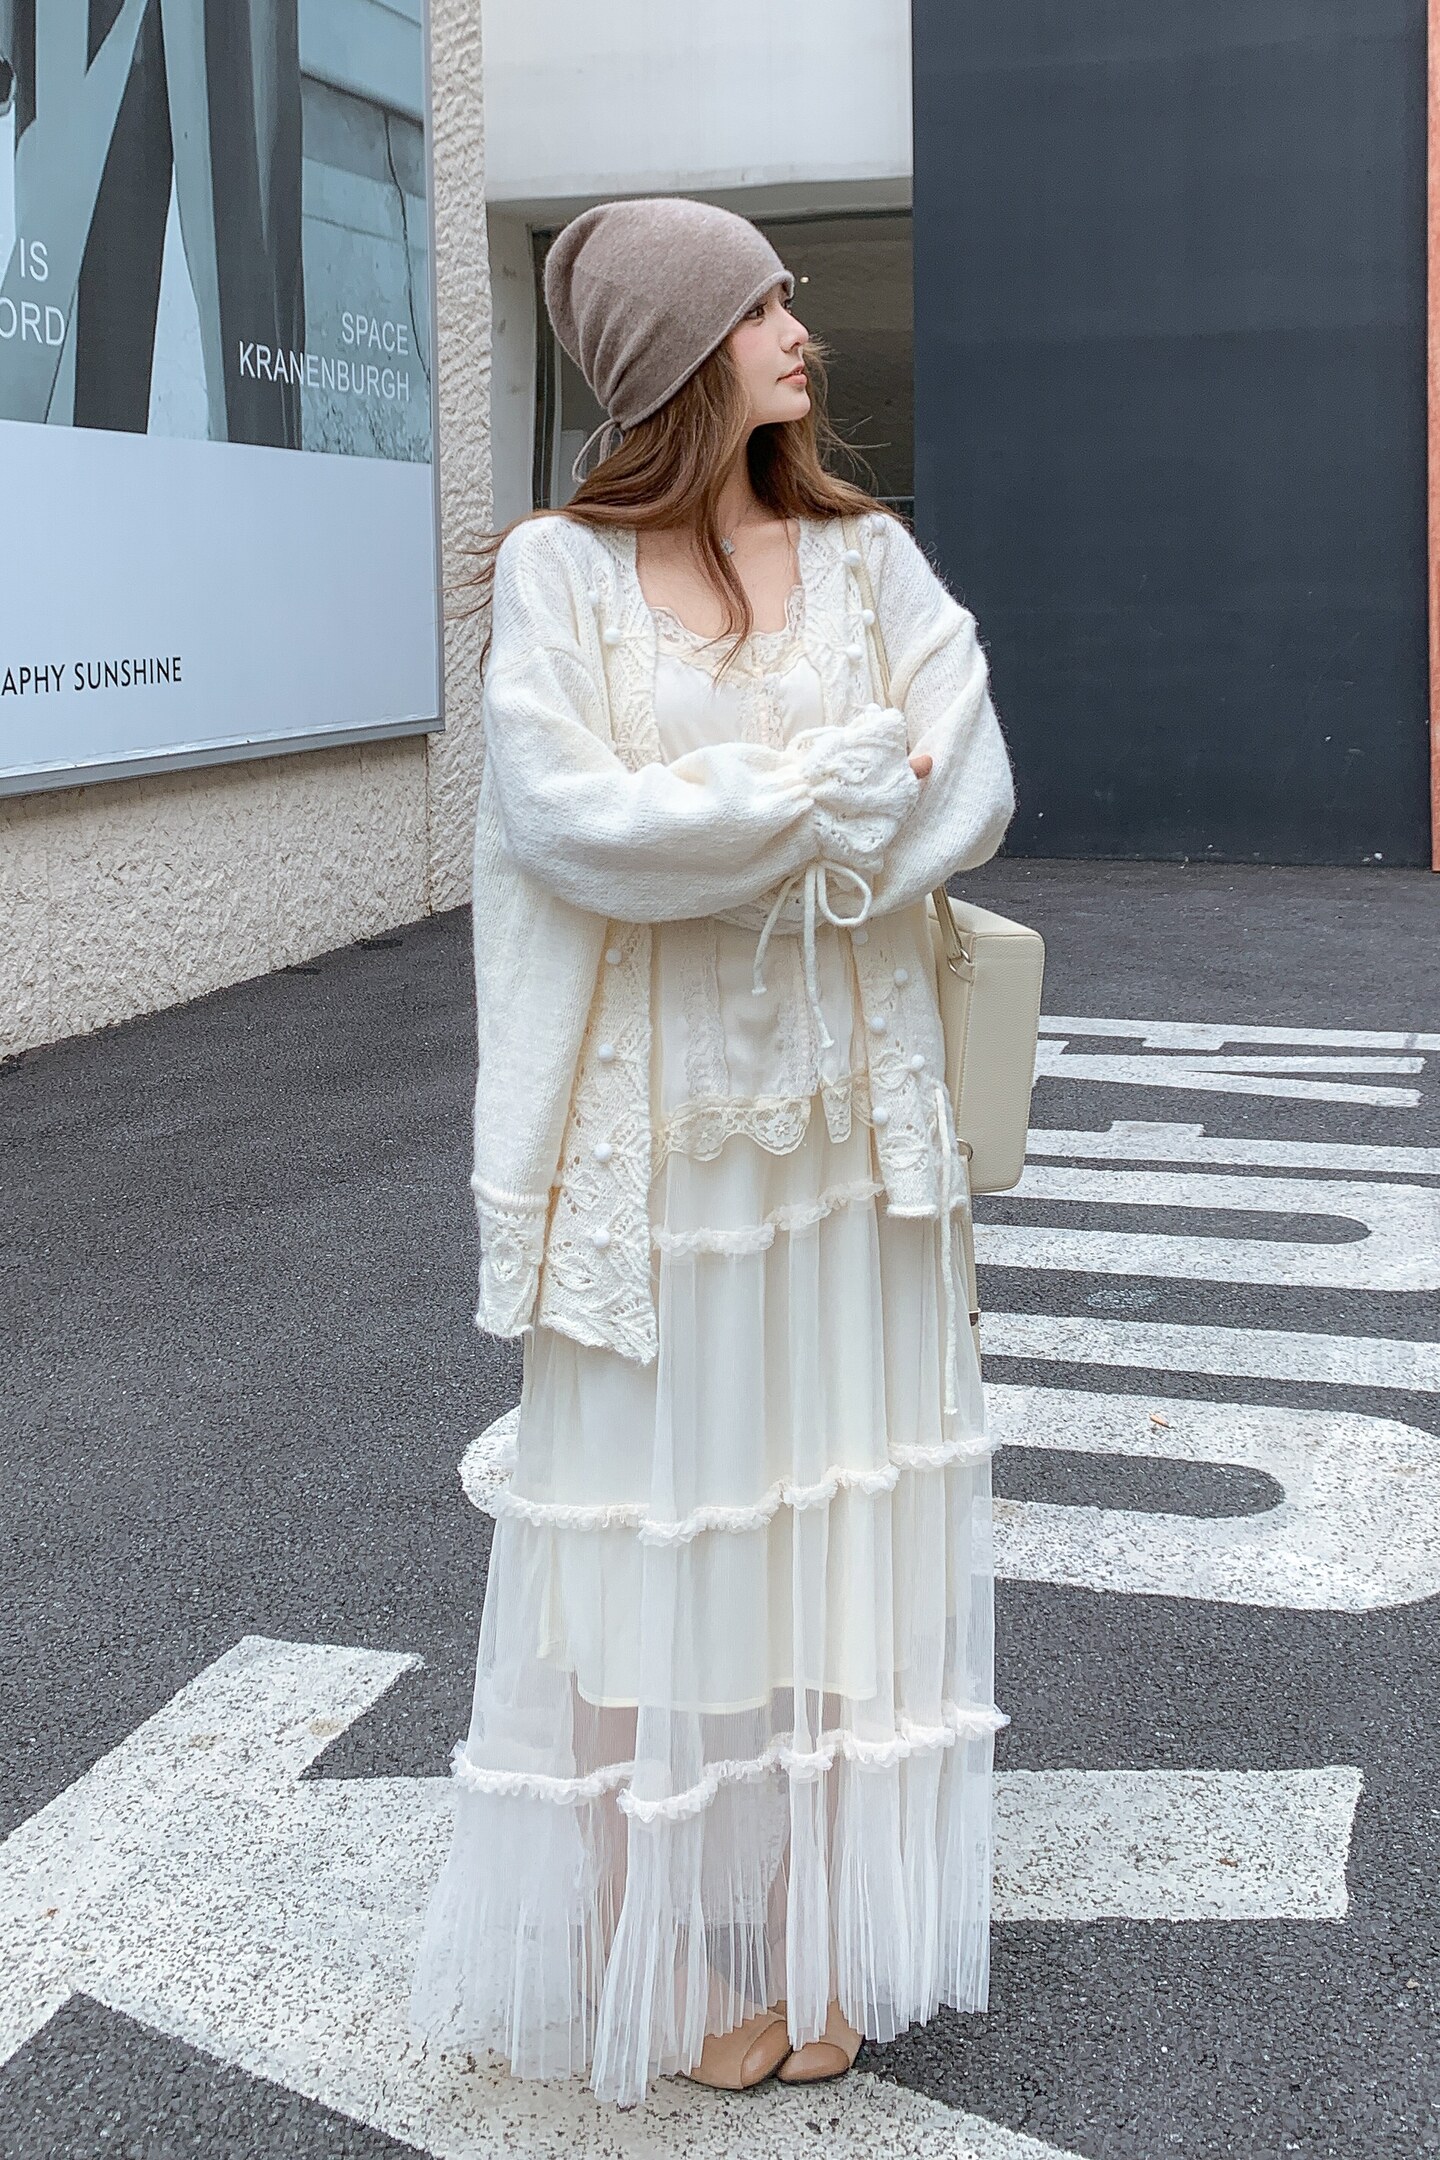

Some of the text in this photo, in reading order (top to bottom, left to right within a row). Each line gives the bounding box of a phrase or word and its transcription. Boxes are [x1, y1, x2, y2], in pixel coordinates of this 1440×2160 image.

[20, 237, 49, 282] IS
[341, 311, 409, 356] SPACE
[238, 340, 410, 402] KRANENBURGH
[73, 656, 183, 691] SUNSHINE
